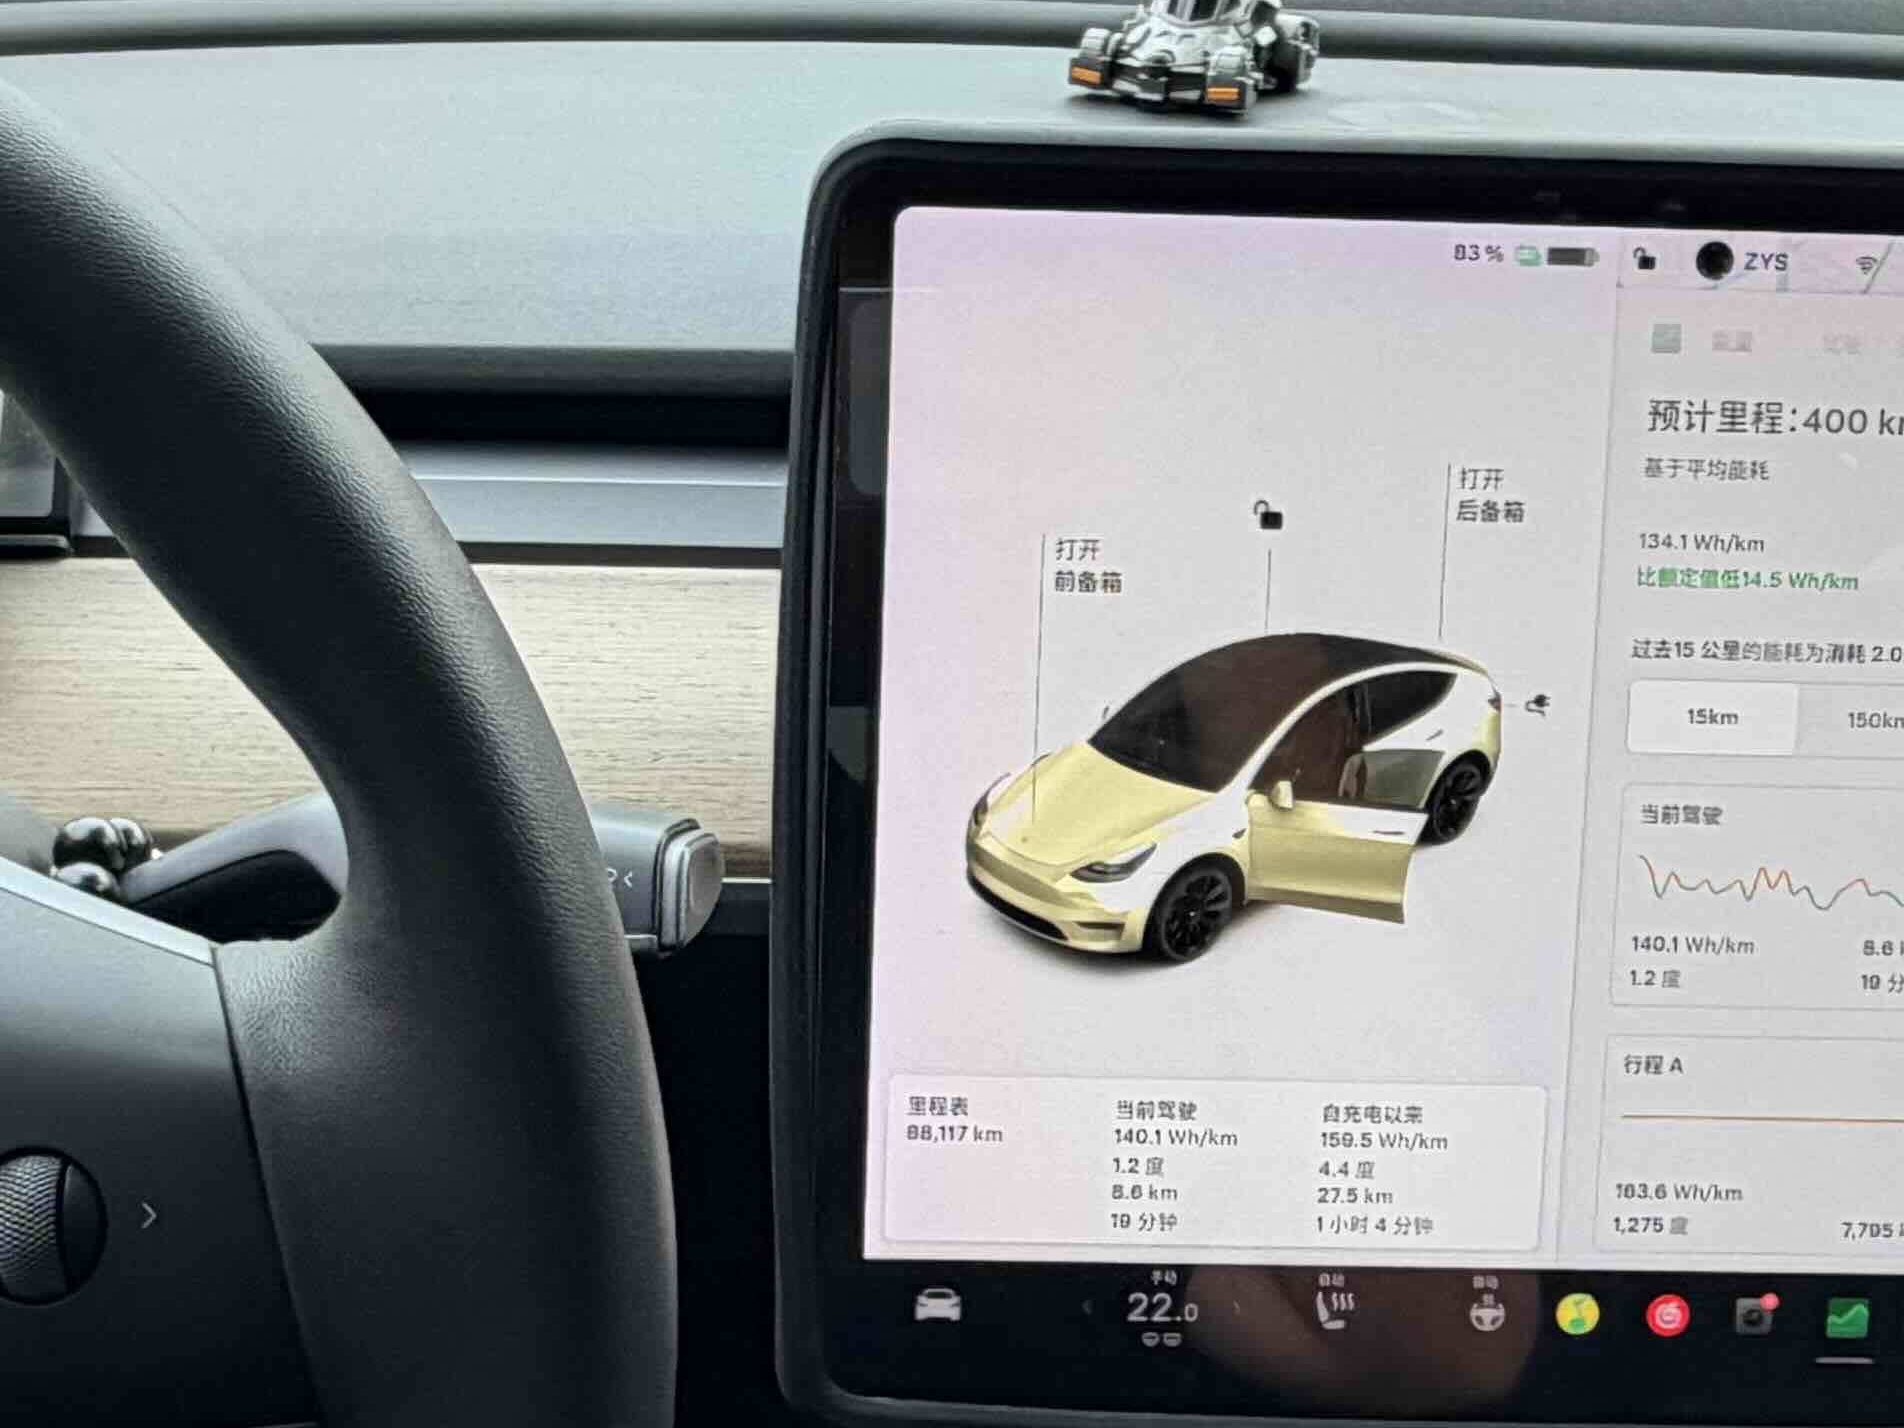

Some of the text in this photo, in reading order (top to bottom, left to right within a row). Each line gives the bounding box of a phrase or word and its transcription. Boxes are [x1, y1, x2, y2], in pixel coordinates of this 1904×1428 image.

[1744, 252, 1789, 271] ZYS
[1648, 399, 1869, 436] 预计里程:400
[1458, 468, 1504, 491] 打开
[1644, 457, 1770, 481] 基于平均能耗
[1456, 500, 1526, 524] 后备箱
[1055, 538, 1100, 561] 打开
[1638, 533, 1765, 554] 134.1 Wh/km
[1789, 571, 1859, 591] Wh/km
[1686, 708, 1740, 727] 15km
[1631, 935, 1756, 957] 140.1 Wh/km
[1630, 969, 1655, 988] 1.2
[1623, 1053, 1684, 1076] 行程 A
[908, 1095, 970, 1118] 里程表
[1116, 1099, 1198, 1122] 当前驾驶
[1321, 1103, 1424, 1126] 自充电以来
[972, 1125, 1004, 1145] km
[1114, 1127, 1239, 1150] 140.1 Wh/km
[1378, 1130, 1449, 1152] Wh/km
[1112, 1157, 1140, 1176] 1.2
[1318, 1159, 1351, 1178] 4.4
[1148, 1183, 1179, 1202] km
[1317, 1186, 1394, 1206] 27.5 km
[1374, 1217, 1387, 1234] 4
[1614, 1217, 1665, 1237] 1,275
[1127, 1291, 1199, 1323] 22.0
